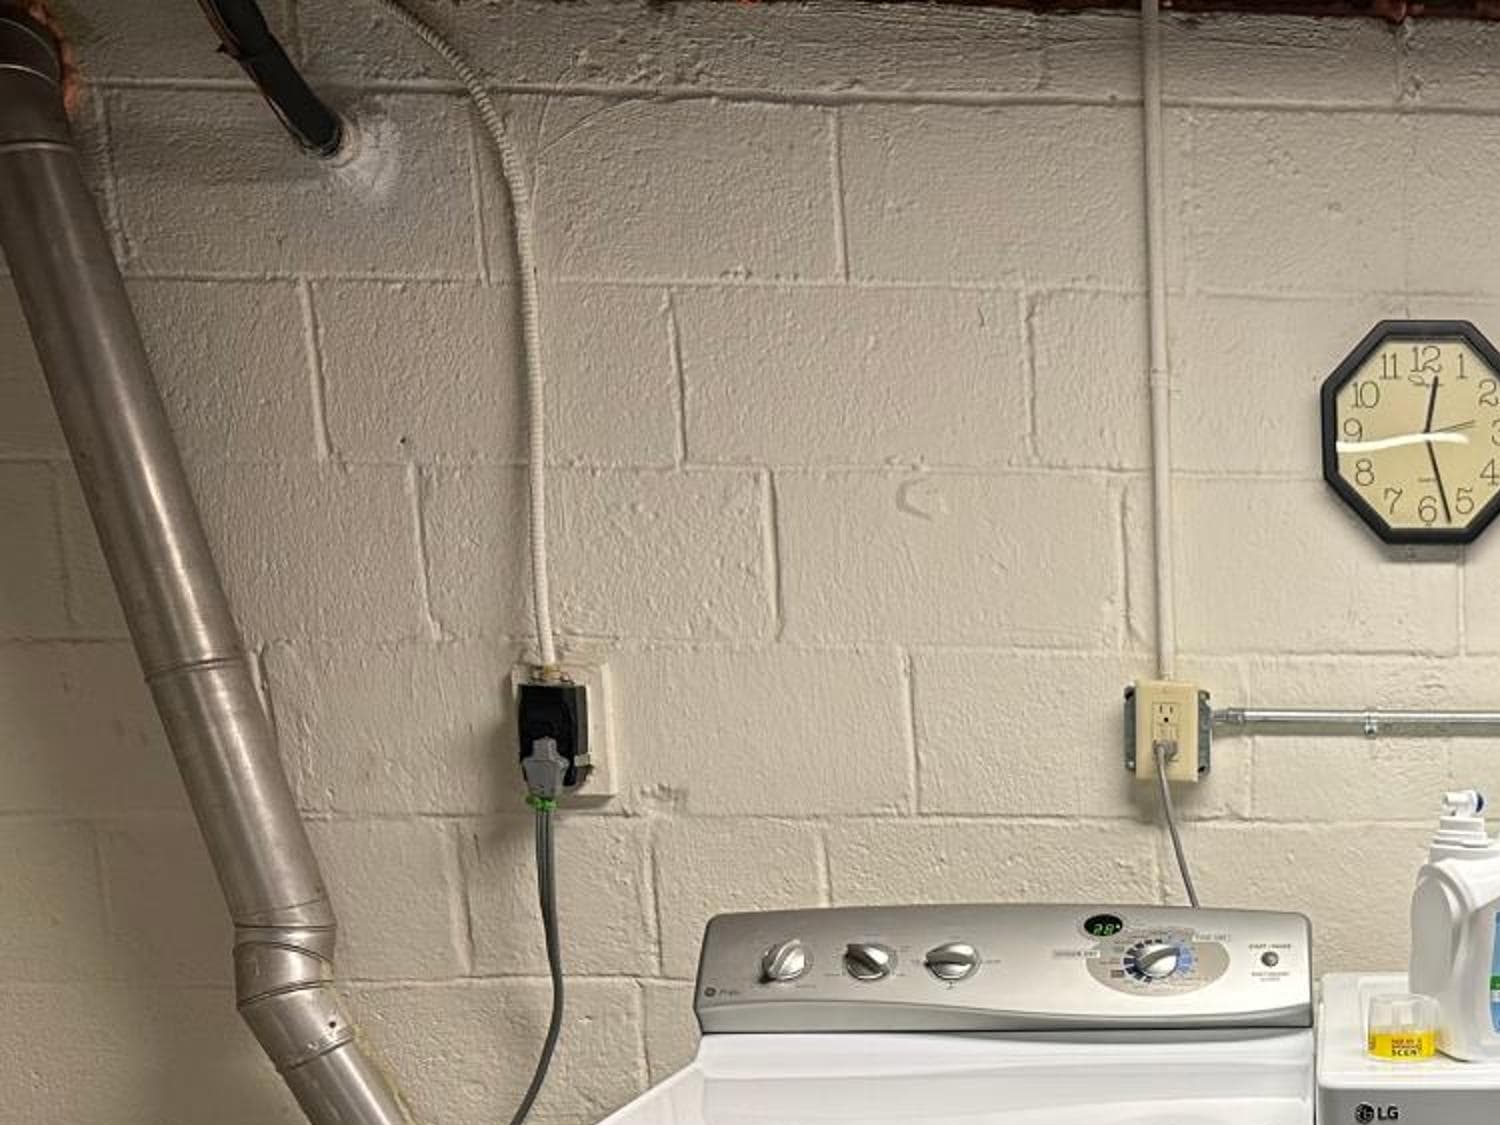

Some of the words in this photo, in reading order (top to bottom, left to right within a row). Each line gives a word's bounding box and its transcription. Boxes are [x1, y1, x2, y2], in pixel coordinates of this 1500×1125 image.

[1379, 353, 1401, 380] 11
[1410, 346, 1442, 374] 12
[1456, 353, 1468, 379] 1
[1351, 381, 1380, 408] 10
[1478, 379, 1499, 407] 2
[1343, 418, 1363, 443] 9
[1355, 459, 1375, 487] 8
[1480, 458, 1500, 486] 4
[1384, 488, 1403, 515] 7
[1418, 496, 1437, 524] 6
[1455, 488, 1475, 515] 5
[1377, 1106, 1399, 1120] LG
